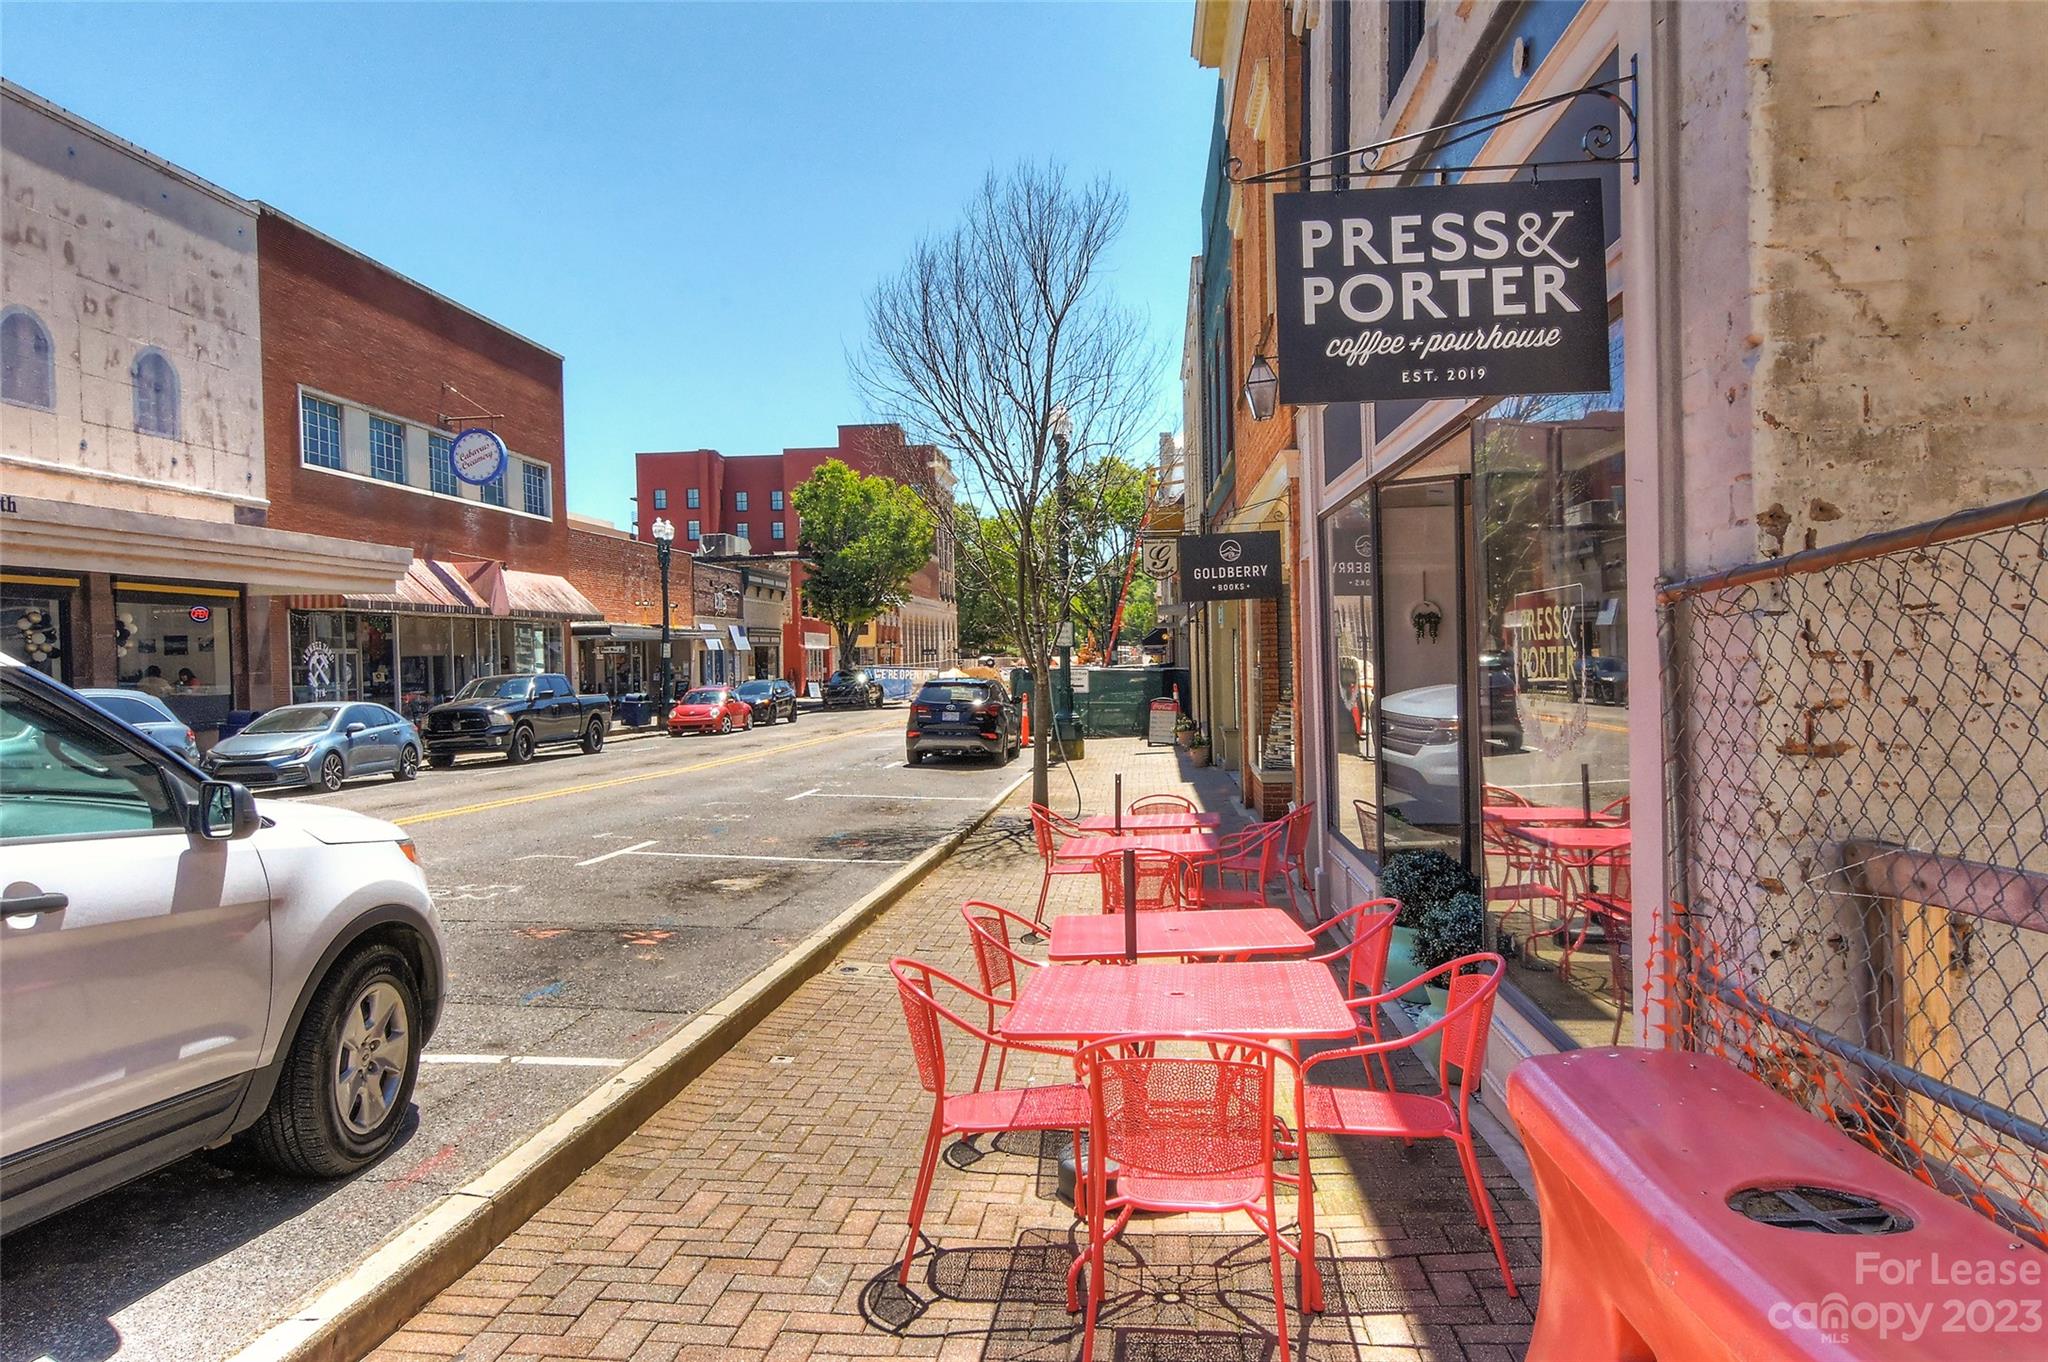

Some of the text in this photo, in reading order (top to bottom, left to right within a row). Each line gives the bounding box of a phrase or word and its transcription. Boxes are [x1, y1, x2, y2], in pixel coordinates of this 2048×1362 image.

[1303, 265, 1581, 325] PORTER
[1401, 367, 1486, 383] EST. 2019
[462, 451, 493, 470] Creamery
[1193, 565, 1268, 580] GOLDBERRY
[1218, 583, 1245, 591] BOOKS
[1521, 645, 1577, 680] PORTER
